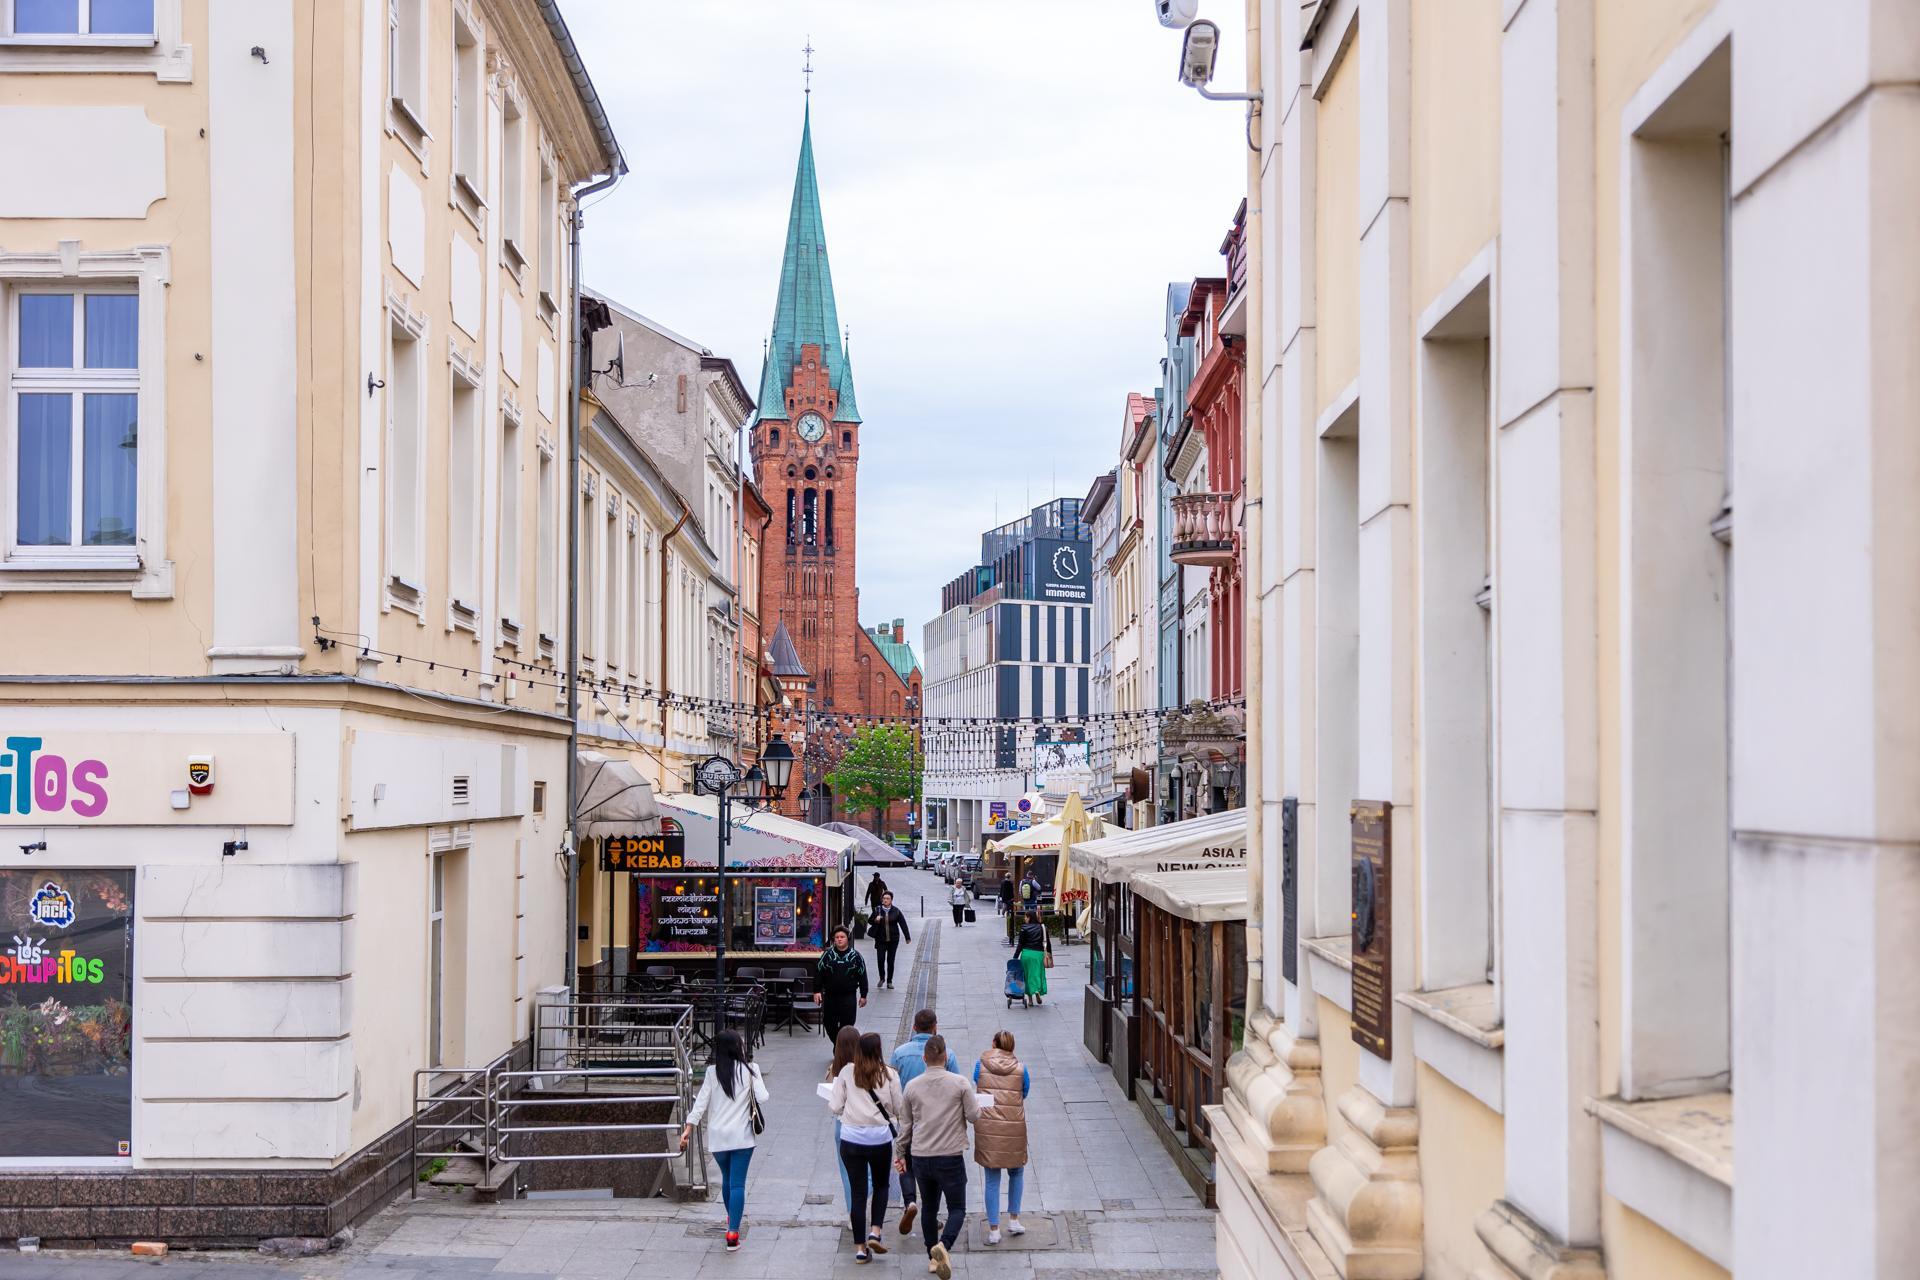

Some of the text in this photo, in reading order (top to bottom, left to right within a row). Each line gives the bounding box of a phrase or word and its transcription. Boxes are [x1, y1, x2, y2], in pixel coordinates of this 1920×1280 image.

[702, 772, 736, 780] BURGER
[626, 839, 665, 853] DON
[1201, 847, 1235, 858] ASIA
[626, 855, 682, 868] KEBAB
